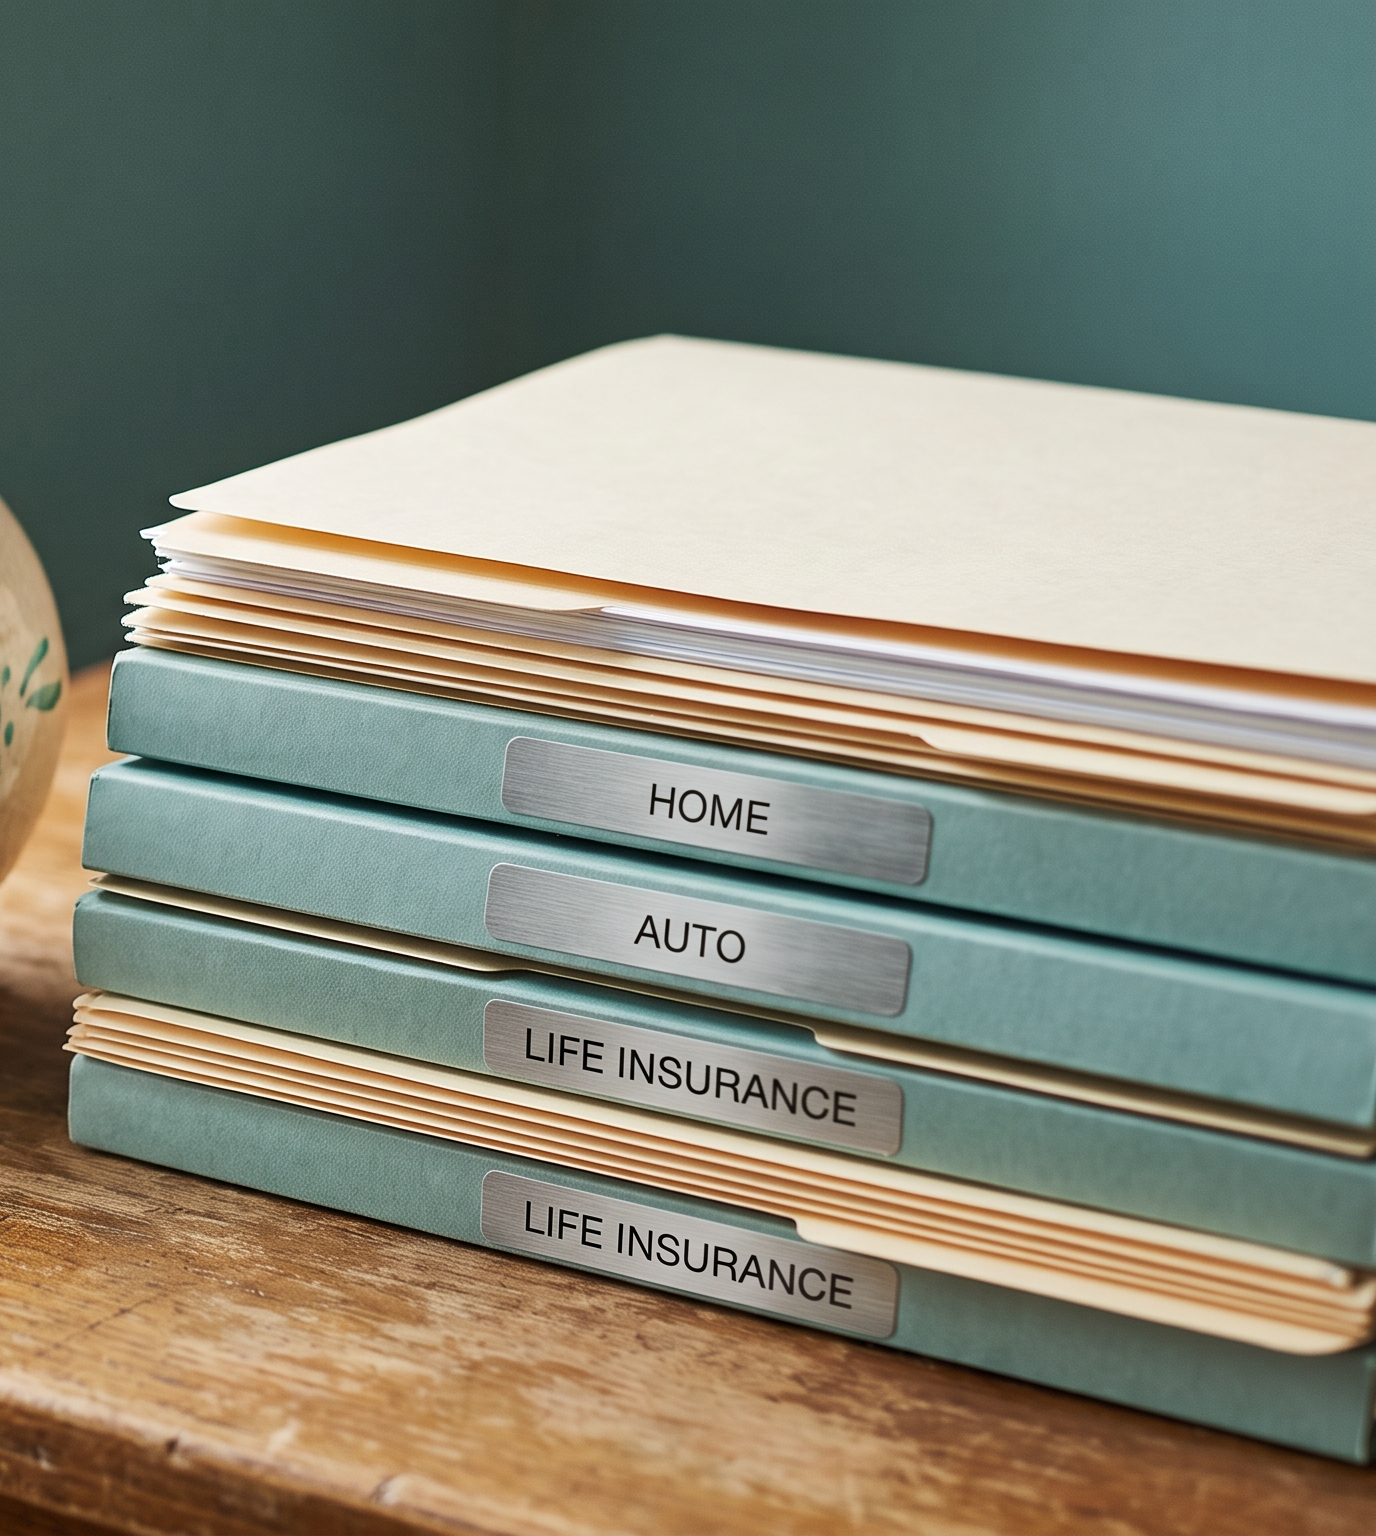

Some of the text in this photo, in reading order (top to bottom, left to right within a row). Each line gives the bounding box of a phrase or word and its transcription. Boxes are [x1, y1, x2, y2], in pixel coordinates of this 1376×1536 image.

[649, 783, 771, 836] HOME
[633, 914, 746, 964] AUTO
[525, 1027, 857, 1127] LIFE INSURANCE
[525, 1200, 854, 1310] LIFE INSURANCE
